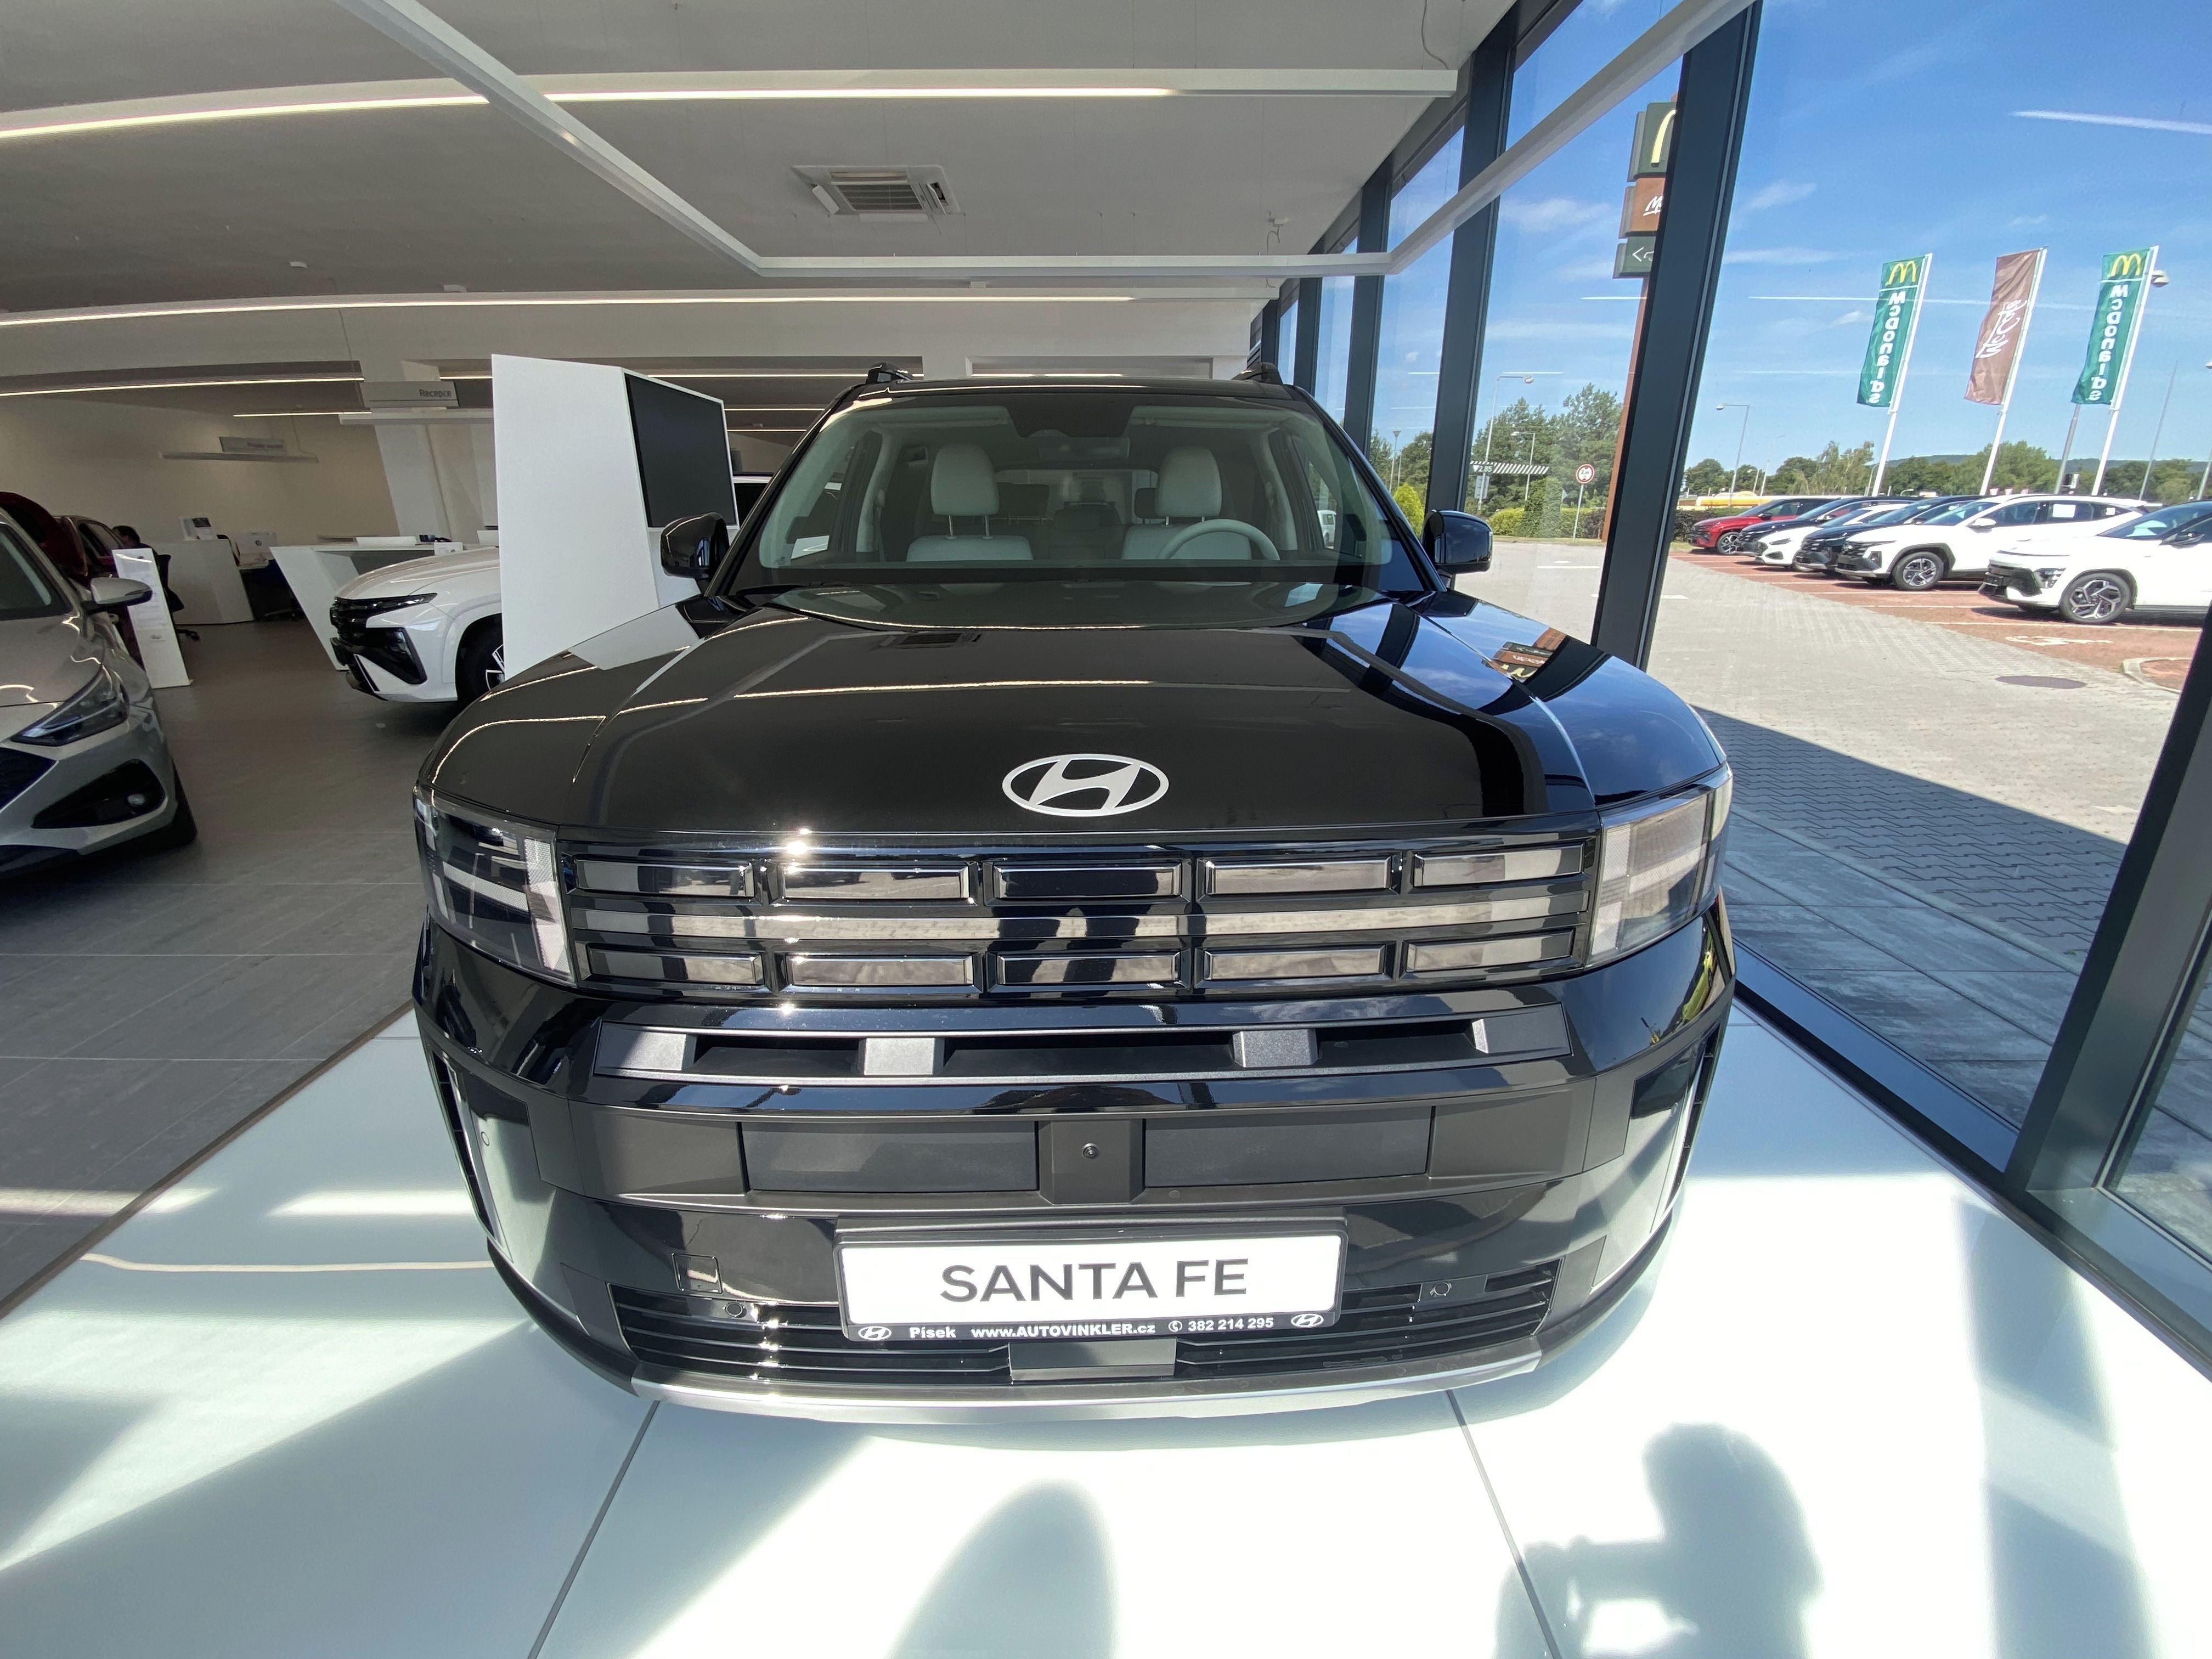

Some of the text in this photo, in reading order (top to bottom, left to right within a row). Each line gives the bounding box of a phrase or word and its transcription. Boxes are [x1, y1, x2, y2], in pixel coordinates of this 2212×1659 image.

[419, 389, 452, 398] Recepce
[940, 1259, 1248, 1302] SANTA FE
[909, 1317, 1274, 1339] Písek www.AUTOVINKLER.cz 382 214 295
